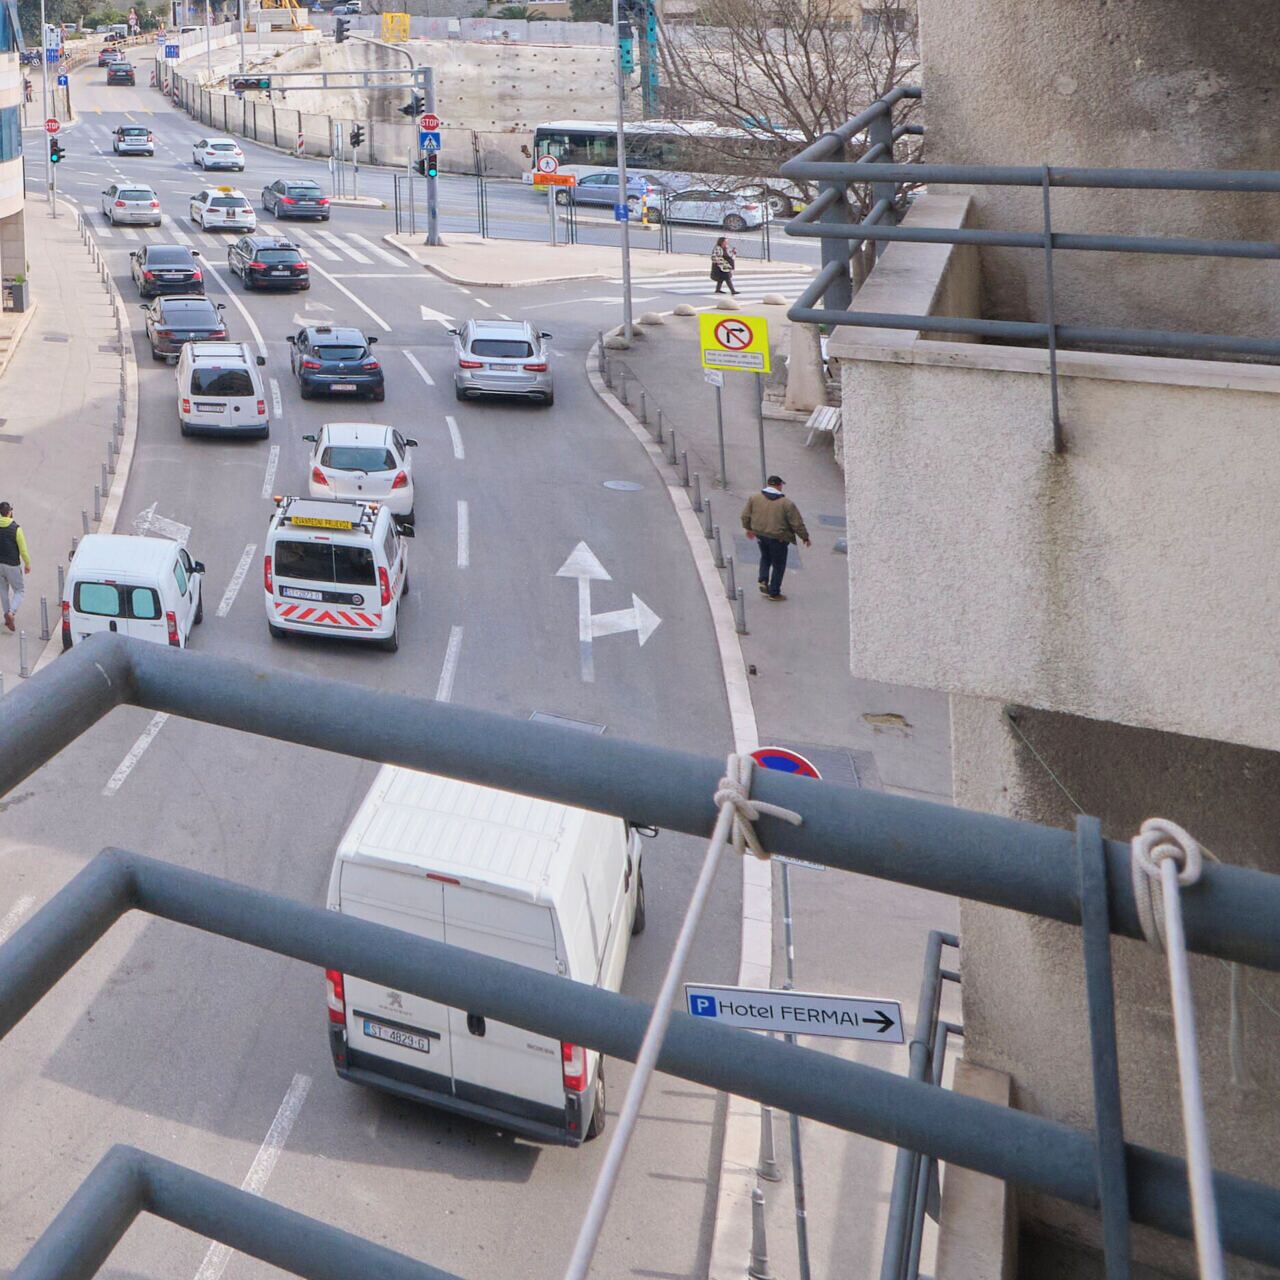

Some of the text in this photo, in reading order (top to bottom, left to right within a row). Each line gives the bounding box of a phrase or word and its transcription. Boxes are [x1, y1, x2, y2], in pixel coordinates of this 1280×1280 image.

[44, 122, 59, 130] STOP
[421, 119, 439, 127] STOP
[720, 1001, 774, 1019] Hotel
[781, 1005, 859, 1027] FERMAI
[369, 1023, 383, 1038] ST
